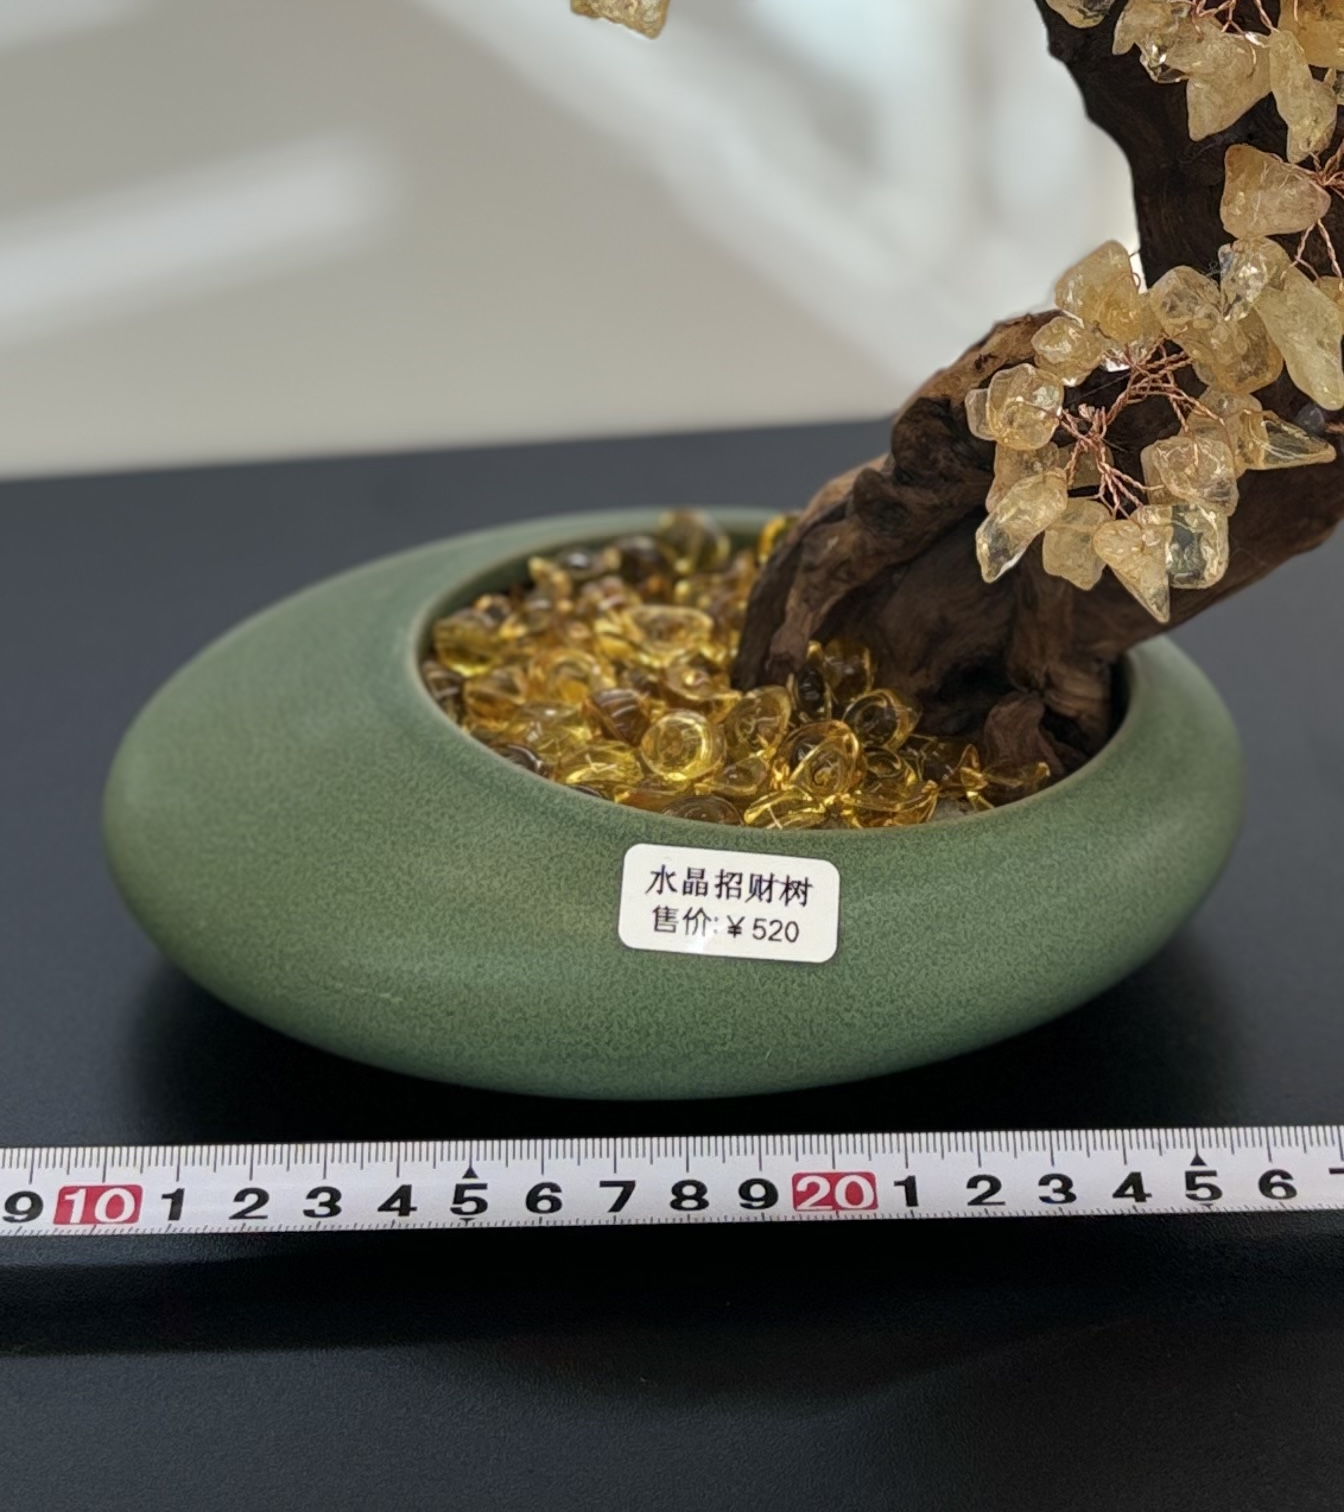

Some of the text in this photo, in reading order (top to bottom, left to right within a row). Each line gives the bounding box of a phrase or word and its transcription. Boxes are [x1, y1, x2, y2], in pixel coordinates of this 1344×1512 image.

[645, 864, 814, 908] 水晶招财树
[3, 1190, 44, 1223] 9
[64, 1188, 135, 1224] 10
[161, 1188, 185, 1221] 1
[229, 1187, 270, 1220] 2
[302, 1186, 342, 1219] 3
[377, 1184, 418, 1217] 4
[449, 1183, 489, 1216] 5
[525, 1181, 563, 1215] 6
[599, 1180, 636, 1213] 7
[669, 1179, 710, 1212] 8
[738, 1178, 779, 1211] 9
[796, 1175, 875, 1210] 20
[893, 1175, 919, 1208] 1
[966, 1174, 1006, 1207] 2
[1038, 1173, 1077, 1205] 3
[1112, 1171, 1153, 1203] 4
[1184, 1170, 1223, 1202] 5
[1258, 1169, 1298, 1200] 6
